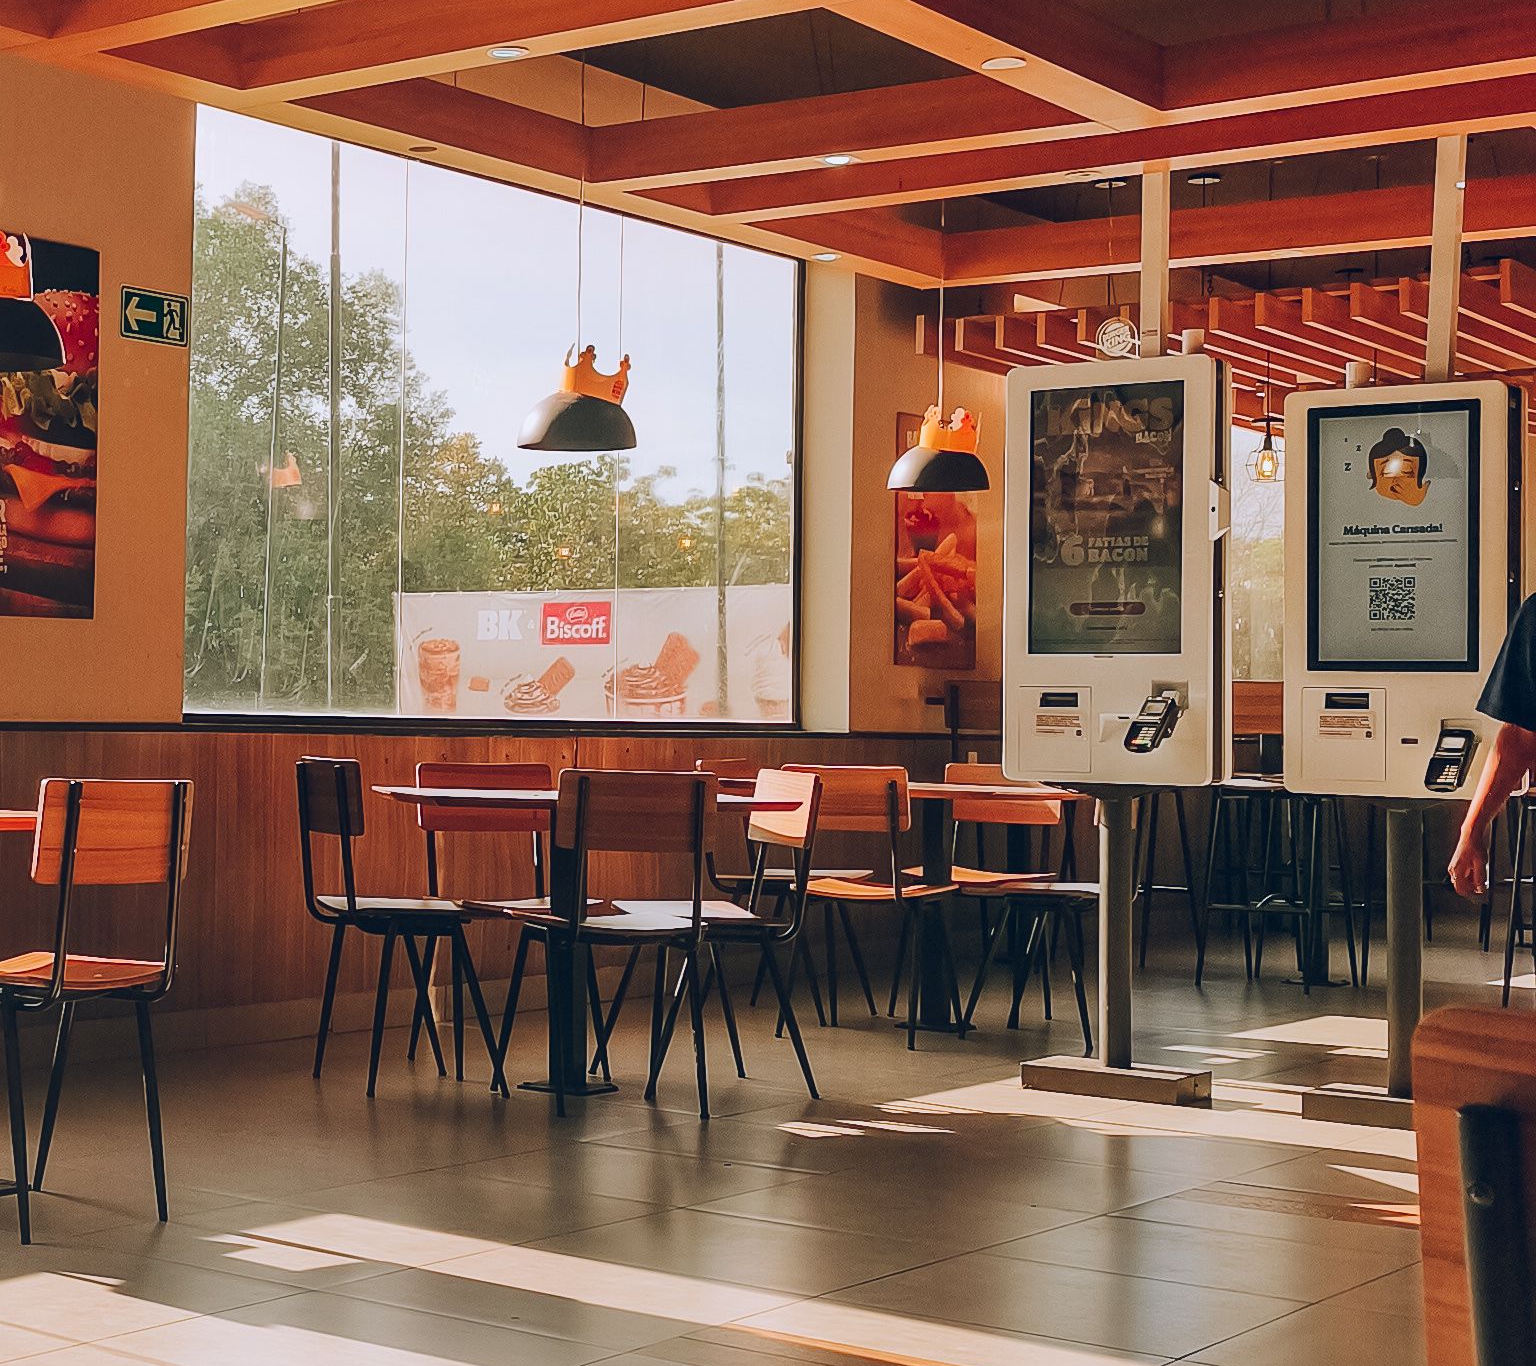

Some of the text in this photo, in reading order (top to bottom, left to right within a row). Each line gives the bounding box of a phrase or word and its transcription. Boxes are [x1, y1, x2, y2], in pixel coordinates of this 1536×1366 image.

[1343, 525, 1390, 537] Máquina
[1088, 536, 1149, 547] FATIAS DE
[1060, 535, 1085, 566] 6
[1088, 547, 1149, 563] BACON
[477, 610, 523, 640] BK
